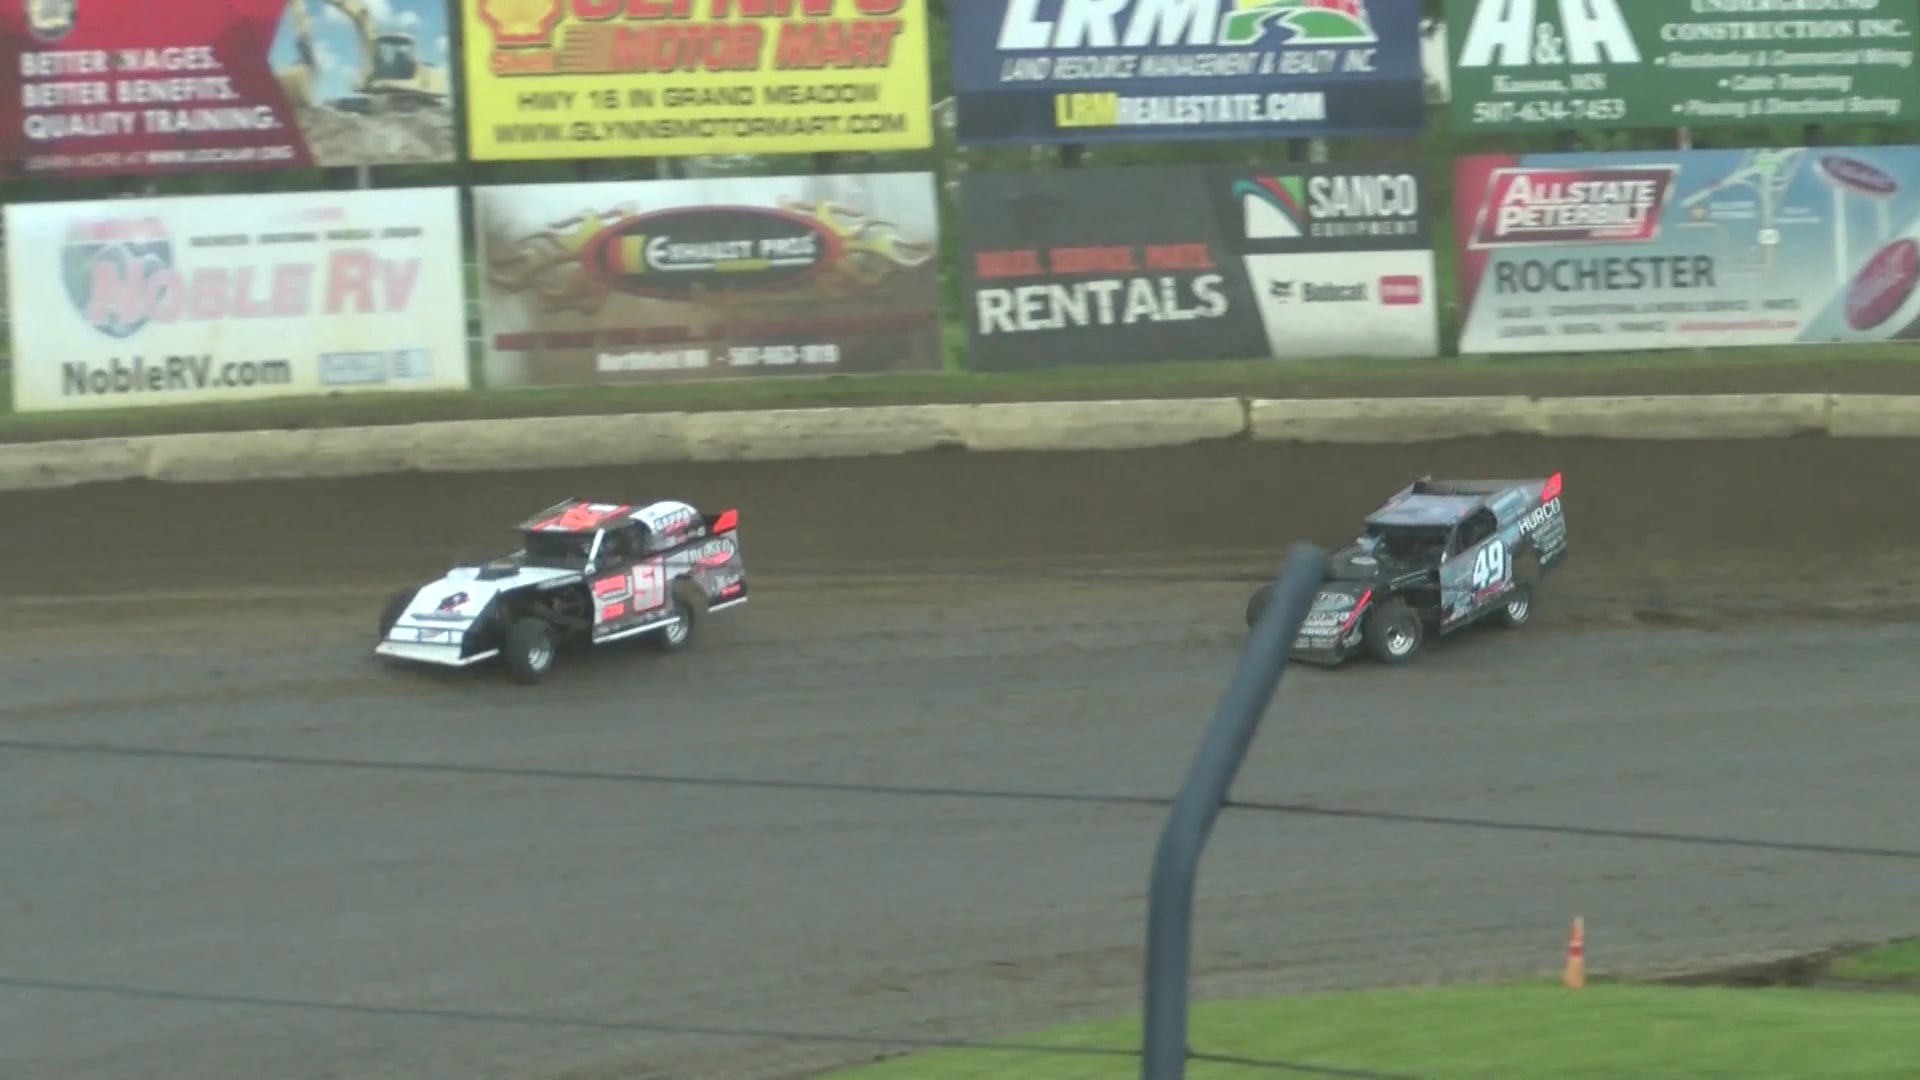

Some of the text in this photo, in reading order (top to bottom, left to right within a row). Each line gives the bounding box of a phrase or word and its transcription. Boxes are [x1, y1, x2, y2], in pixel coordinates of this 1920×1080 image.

[608, 19, 904, 72] MOTOR MART
[1660, 19, 1854, 42] CONSTRUCTION
[21, 46, 223, 76] BETTER WAGES.
[1000, 57, 1051, 82] LAND
[1052, 55, 1138, 80] RESOURCE
[1137, 53, 1260, 79] MANAGEMENT
[22, 76, 240, 107] BETTER BENEFITS.
[517, 90, 577, 111] HWY
[663, 86, 754, 108] GRAND
[763, 82, 881, 105] MEADOW
[23, 104, 284, 140] QUALITY TRAINING.
[1055, 92, 1327, 128] LRMREALESTATE.COM
[1308, 174, 1418, 218] SANCO
[1504, 174, 1657, 207] ALLSTATE
[1309, 220, 1419, 237] EQUIPMENT
[1496, 202, 1652, 237] PETERBILT
[90, 258, 317, 326] NOBLE
[1494, 255, 1716, 295] ROCHESTER
[976, 273, 1229, 335] RENTALS
[61, 353, 293, 397] NobleRV.com
[1518, 496, 1562, 536] HURCO
[1472, 538, 1506, 590] 49
[632, 553, 667, 613] 51
